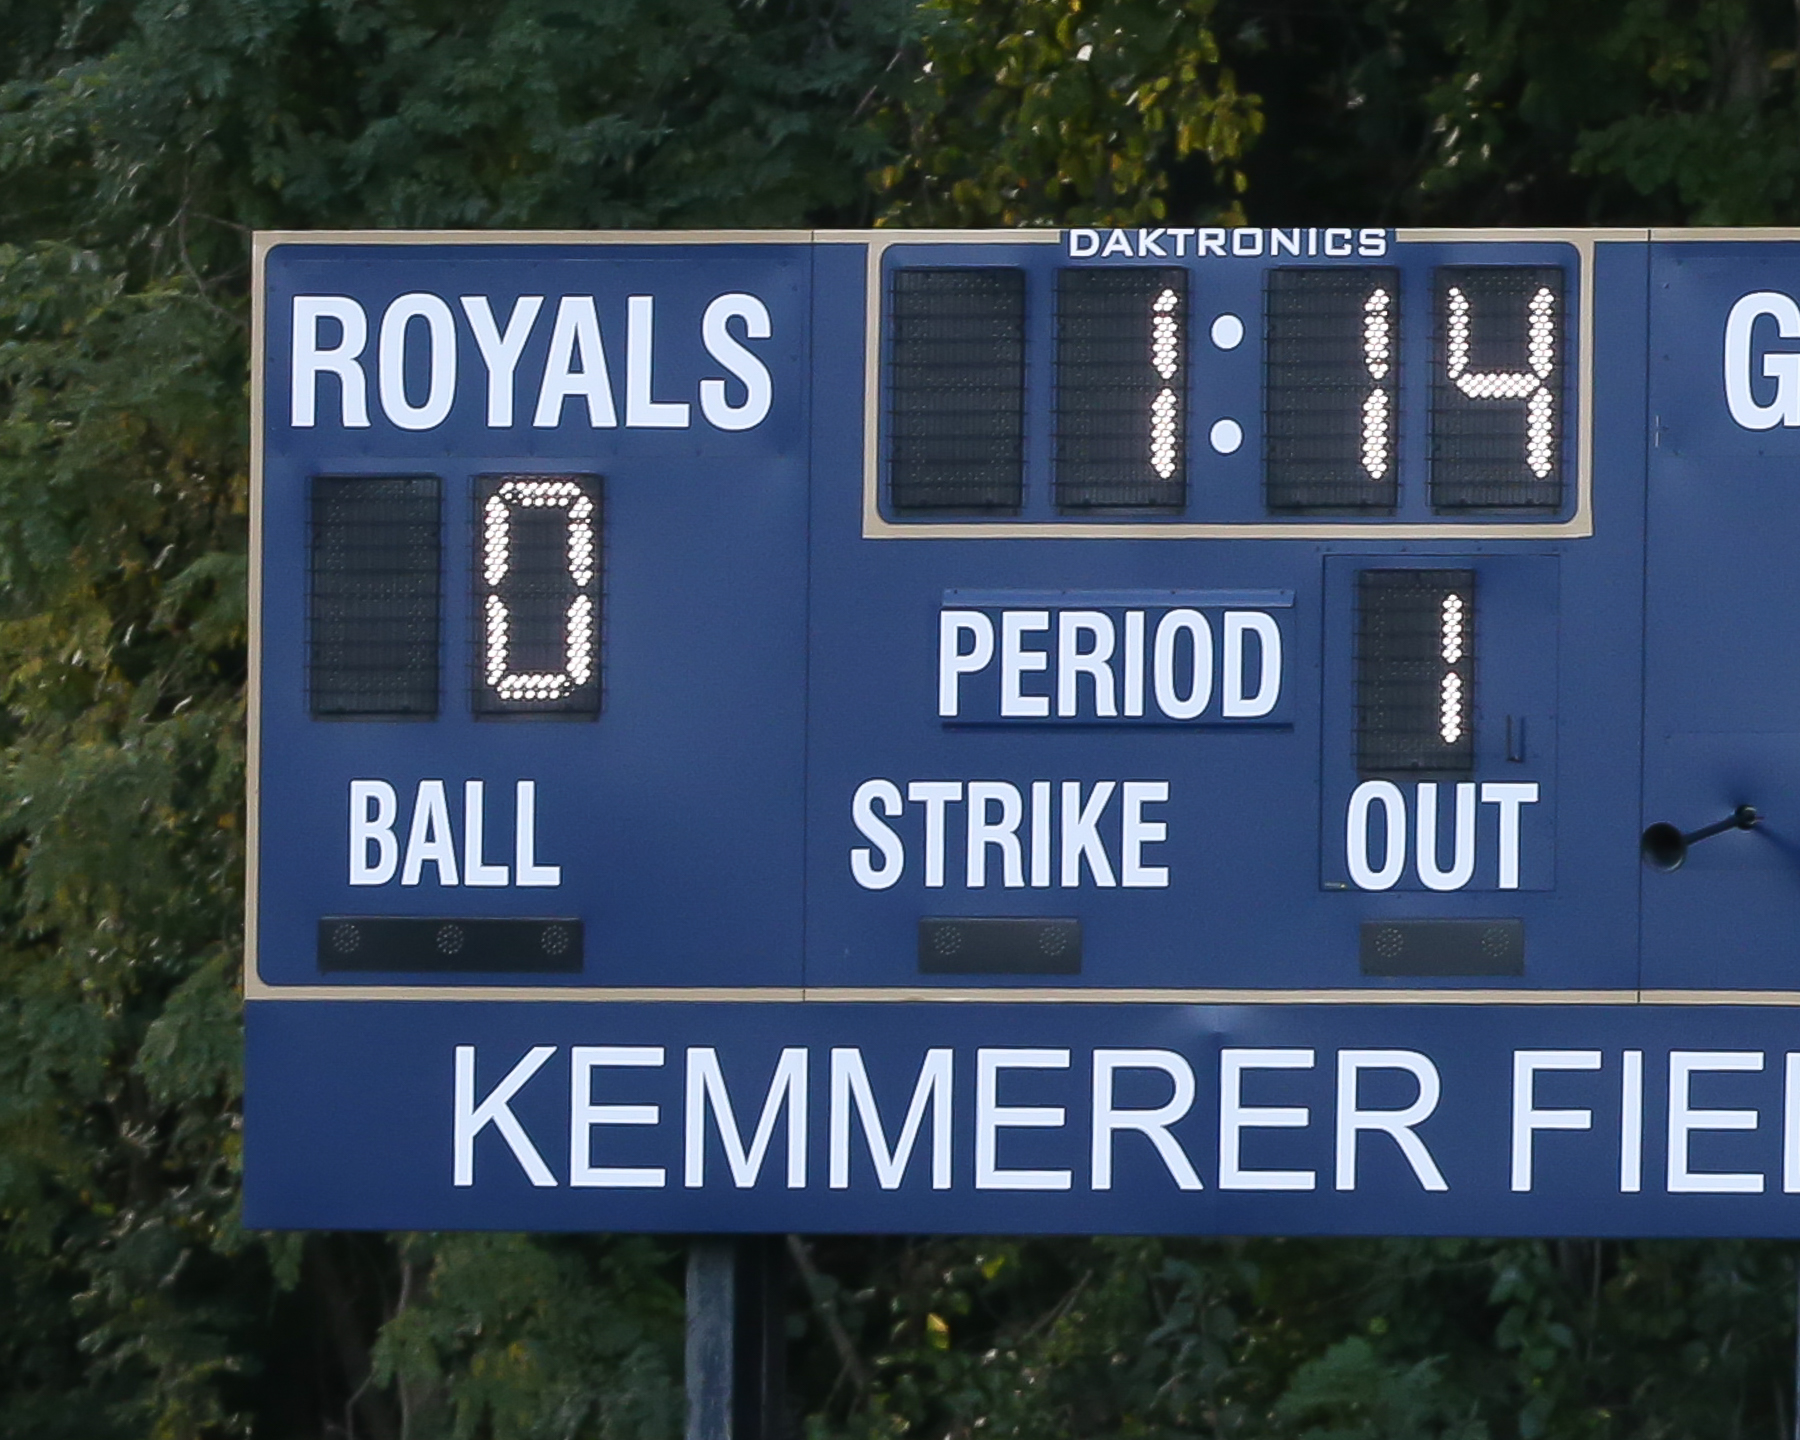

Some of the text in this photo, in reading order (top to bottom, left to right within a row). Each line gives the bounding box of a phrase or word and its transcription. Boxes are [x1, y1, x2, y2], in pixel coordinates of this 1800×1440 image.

[1068, 226, 1387, 258] DAKTRONICS
[291, 292, 773, 431] ROYALS
[1149, 286, 1556, 480] 1:14
[483, 480, 594, 701] 0
[938, 608, 1283, 720] PERIOD
[1440, 593, 1465, 744] 1
[348, 779, 561, 887] BALL
[850, 778, 1170, 890] STRIKE
[1346, 780, 1539, 892] OUT
[453, 1045, 1449, 1192] KEMMERER
